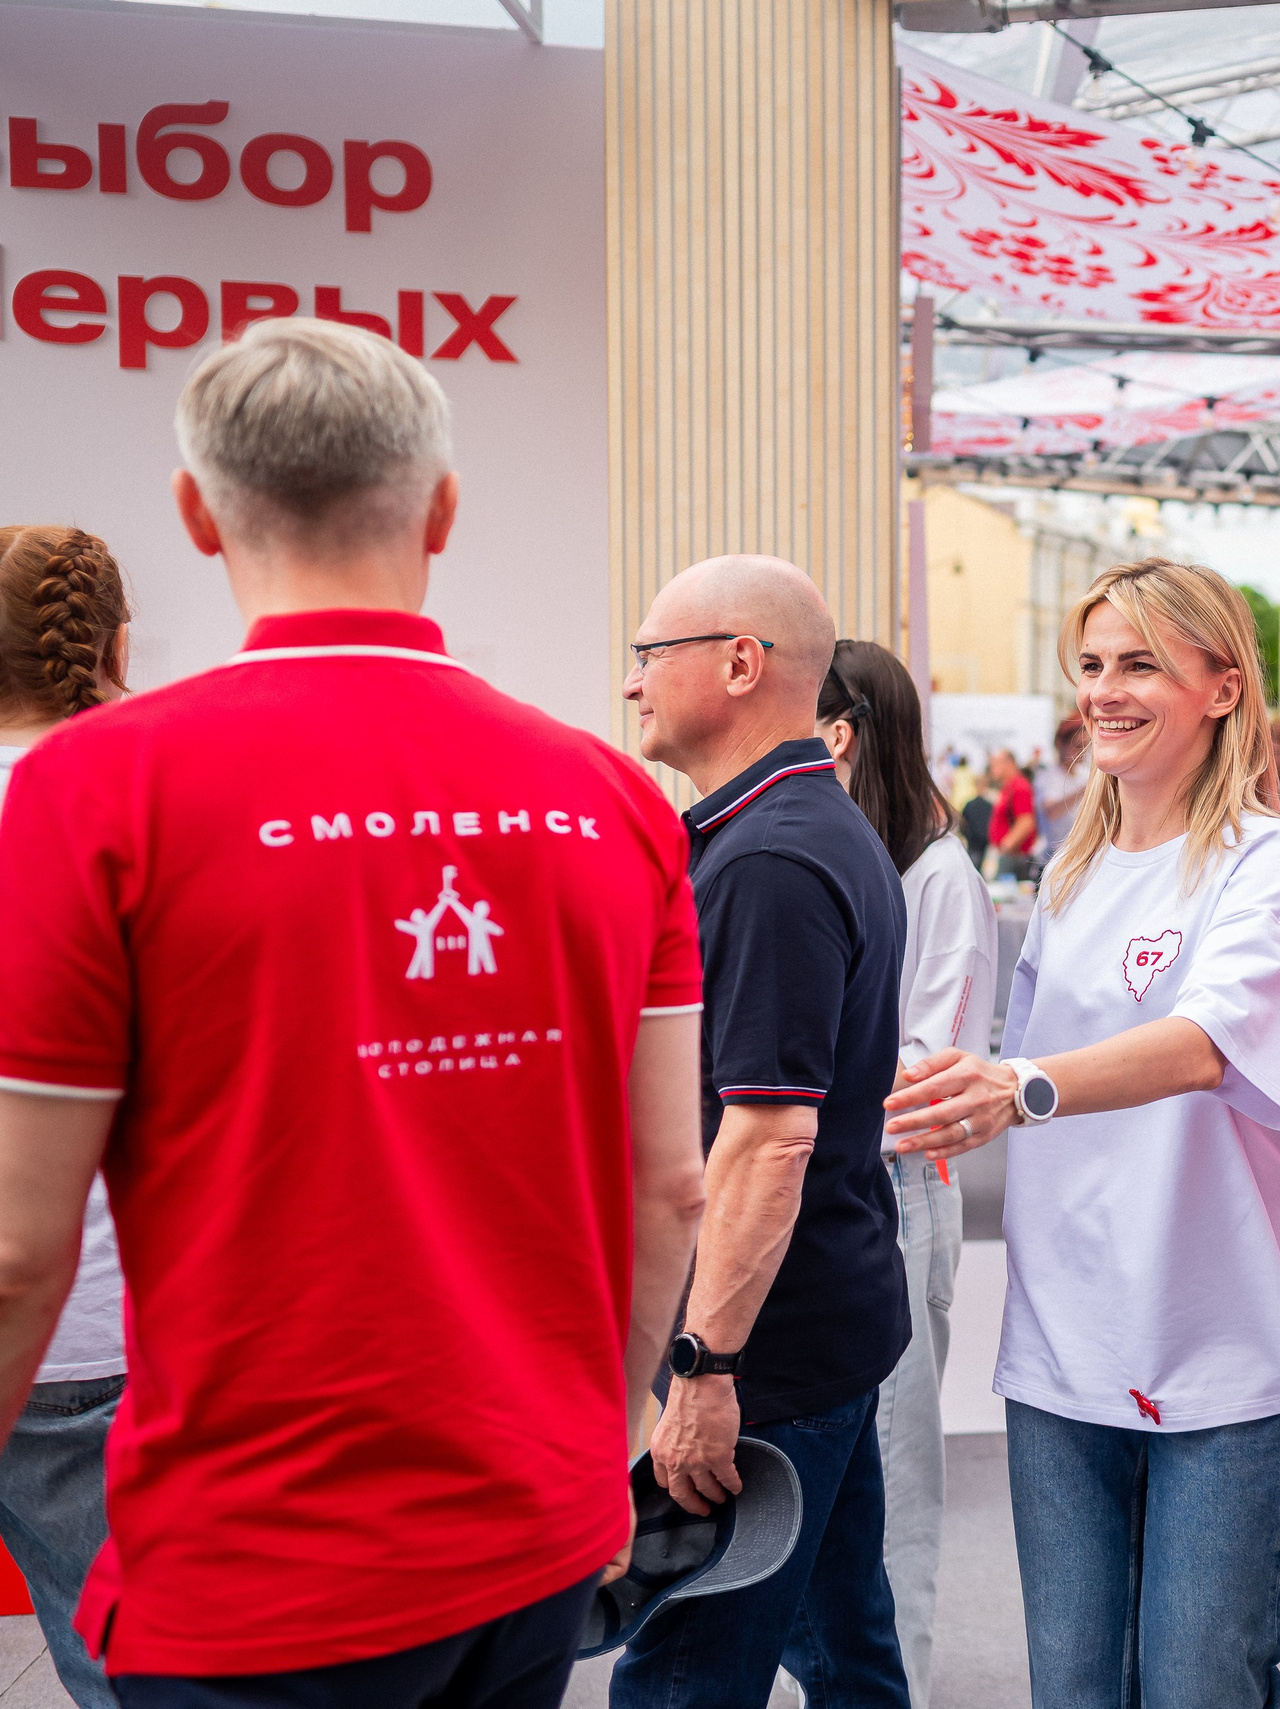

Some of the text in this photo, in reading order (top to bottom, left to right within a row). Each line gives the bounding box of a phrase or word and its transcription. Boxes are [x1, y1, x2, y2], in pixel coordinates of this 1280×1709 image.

[0, 99, 432, 233] ыбор
[0, 244, 519, 370] ервых
[259, 810, 600, 847] СМОЛЕНСК
[1136, 951, 1163, 966] 67
[378, 1053, 521, 1079] СТОЛИЦА
